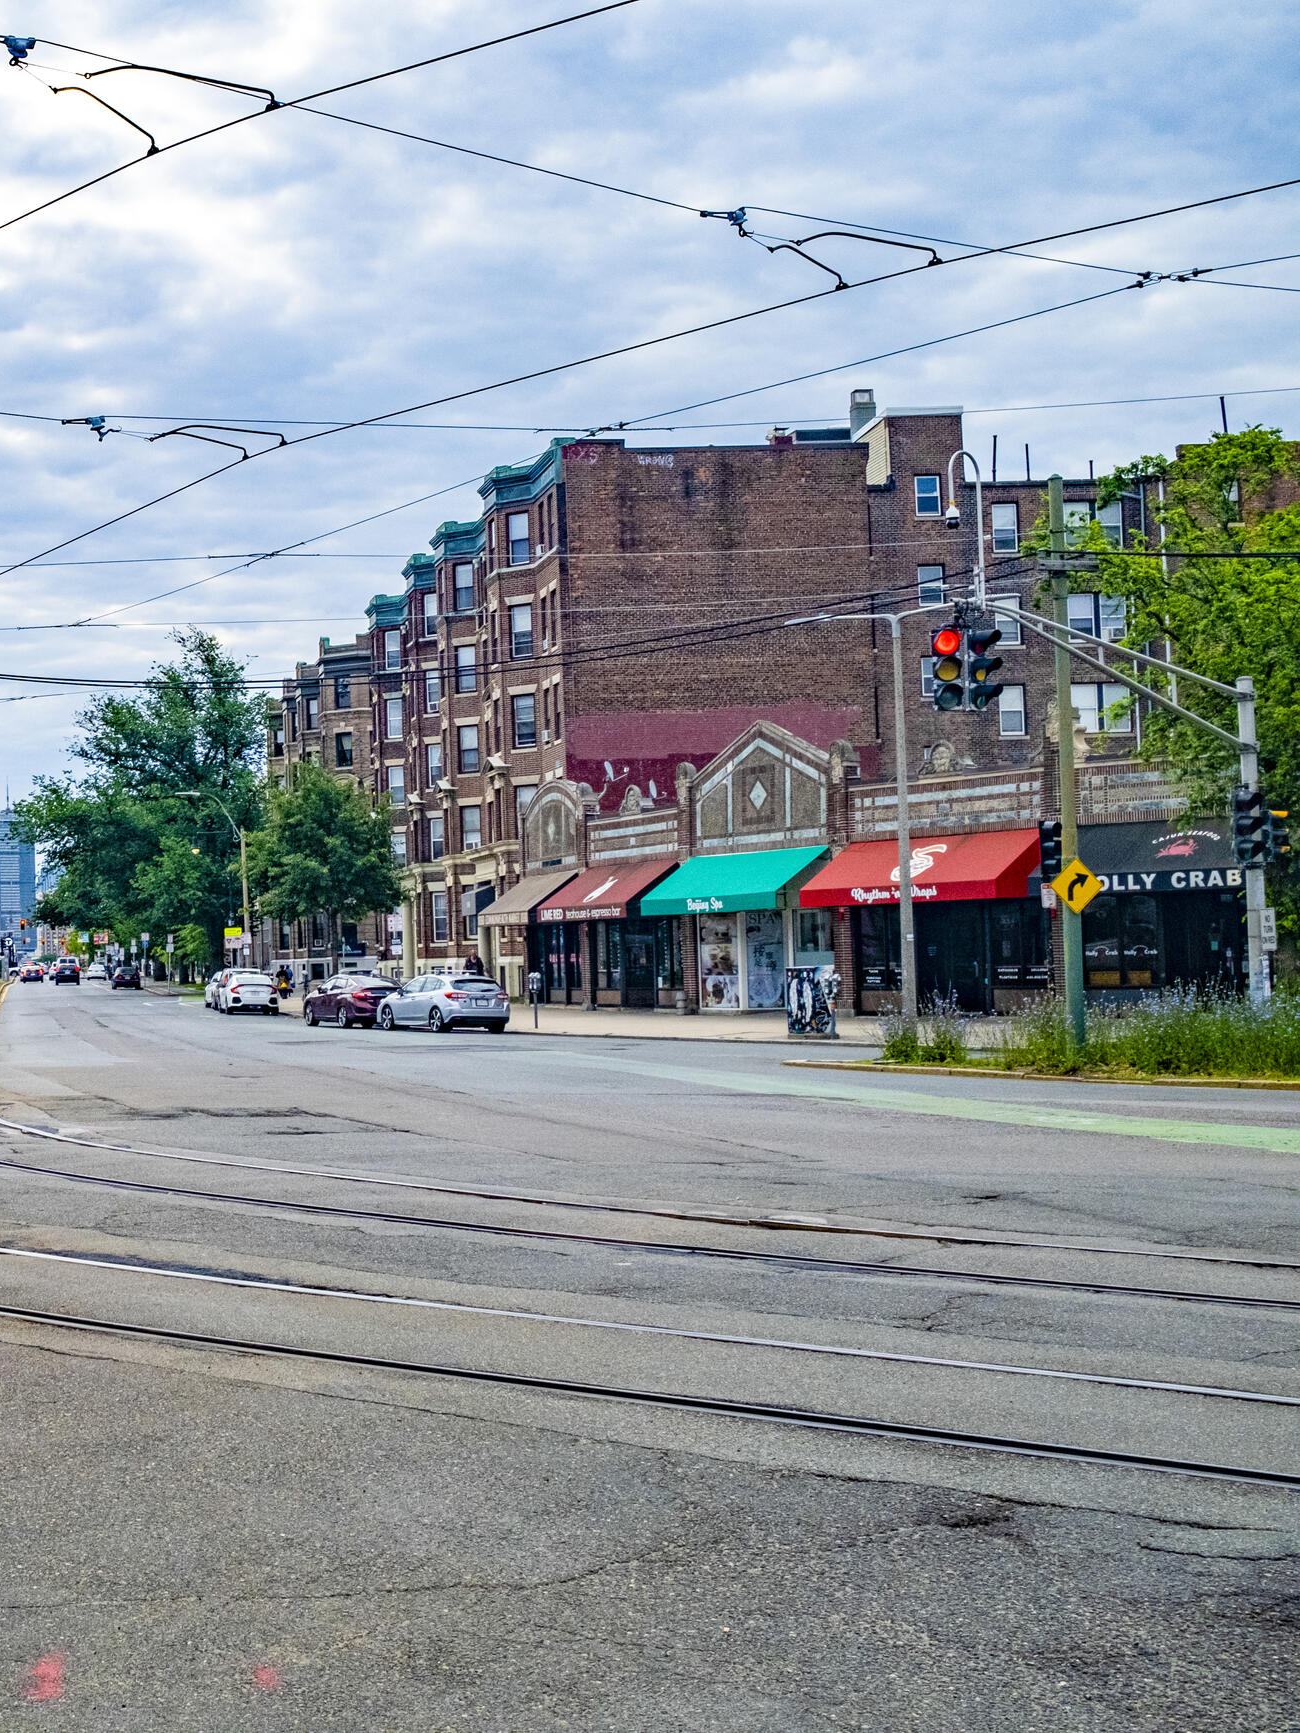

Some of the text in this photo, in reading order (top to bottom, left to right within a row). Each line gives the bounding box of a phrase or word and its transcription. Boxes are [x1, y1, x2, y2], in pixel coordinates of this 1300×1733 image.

[1152, 830, 1221, 844] CAJUN SEAFOOD
[1097, 869, 1242, 892] OLLY CRAB
[851, 887, 891, 904] Rhythm
[710, 897, 723, 912] Spa
[566, 908, 587, 919] teahouse
[591, 908, 611, 919] espresso
[612, 905, 621, 916] bar
[748, 913, 775, 924] SPA
